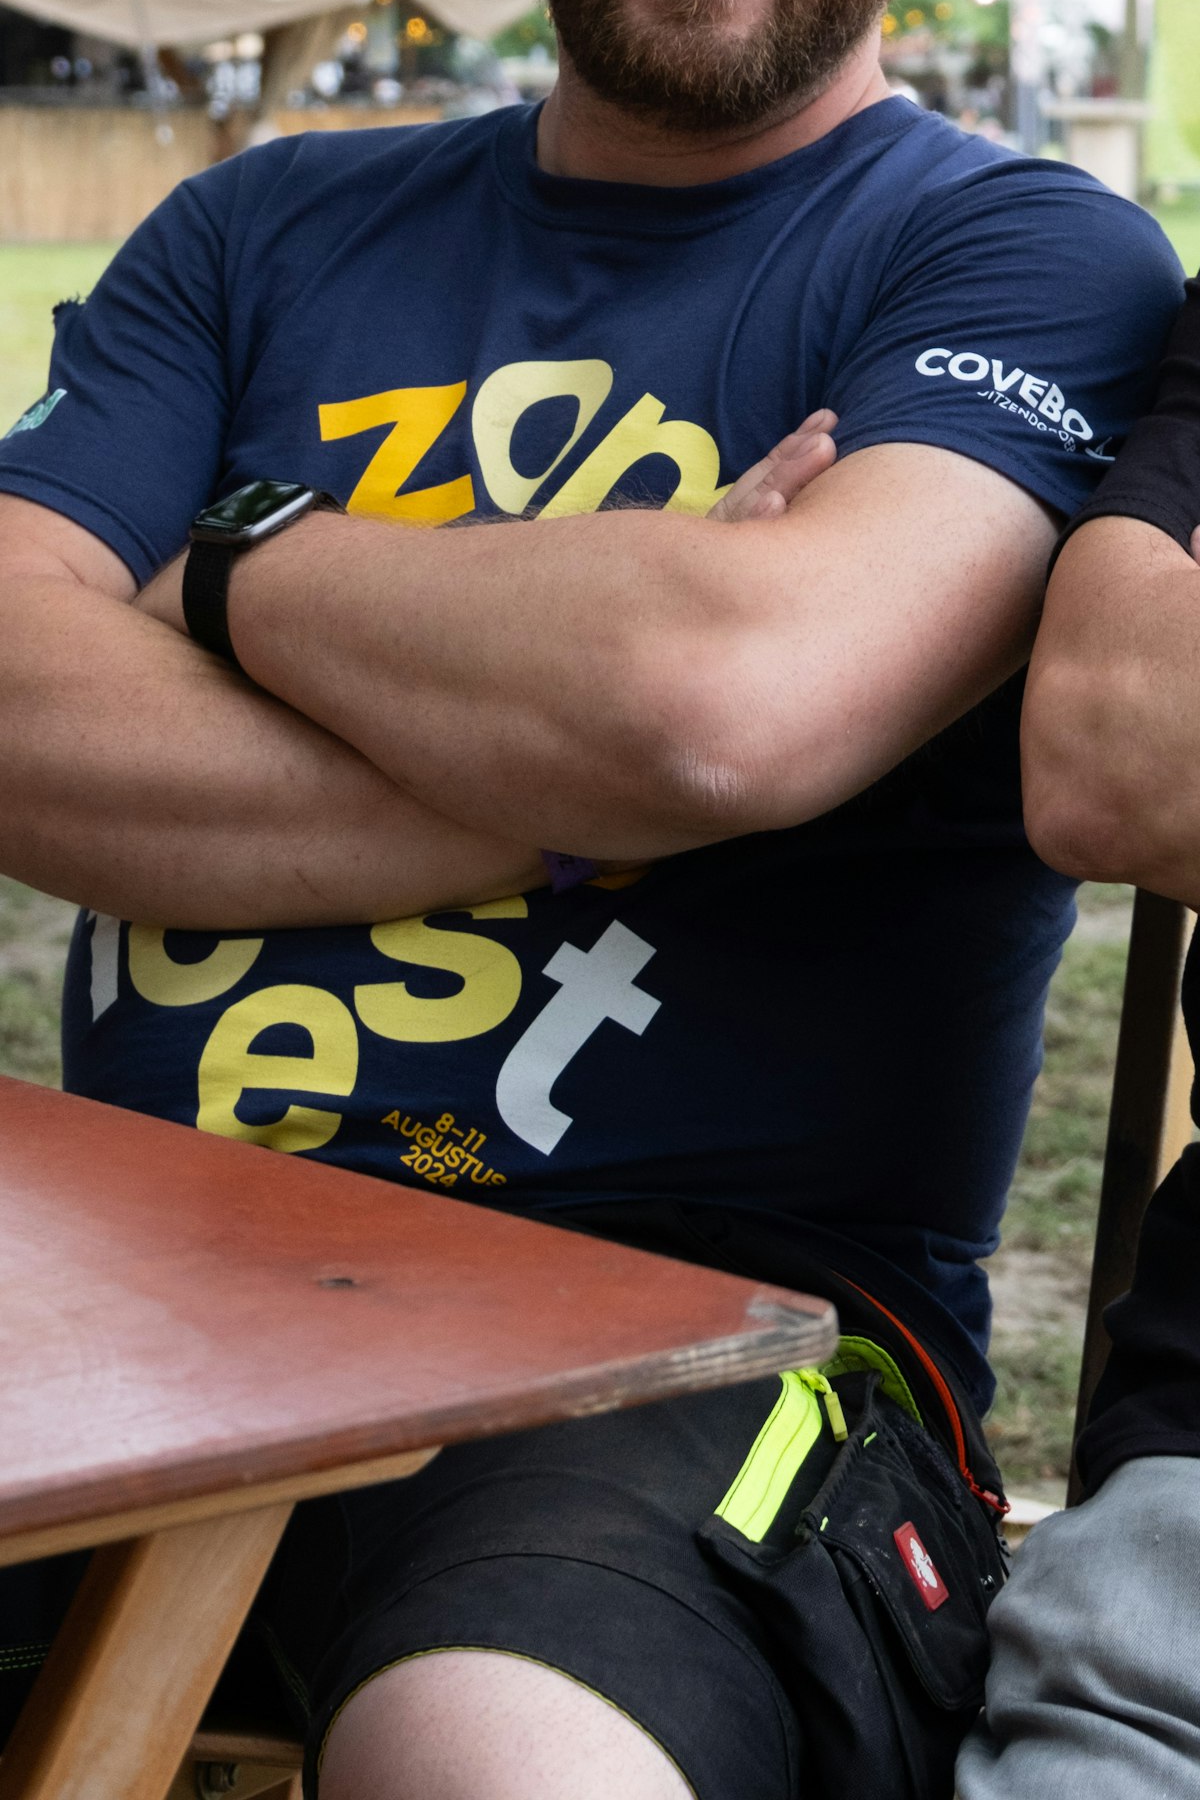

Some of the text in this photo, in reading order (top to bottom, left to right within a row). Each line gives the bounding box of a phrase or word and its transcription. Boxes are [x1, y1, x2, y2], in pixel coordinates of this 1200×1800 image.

[915, 347, 1093, 441] COVEBO
[380, 1109, 508, 1187] AUGUSTUS
[400, 1144, 459, 1188] 2024
